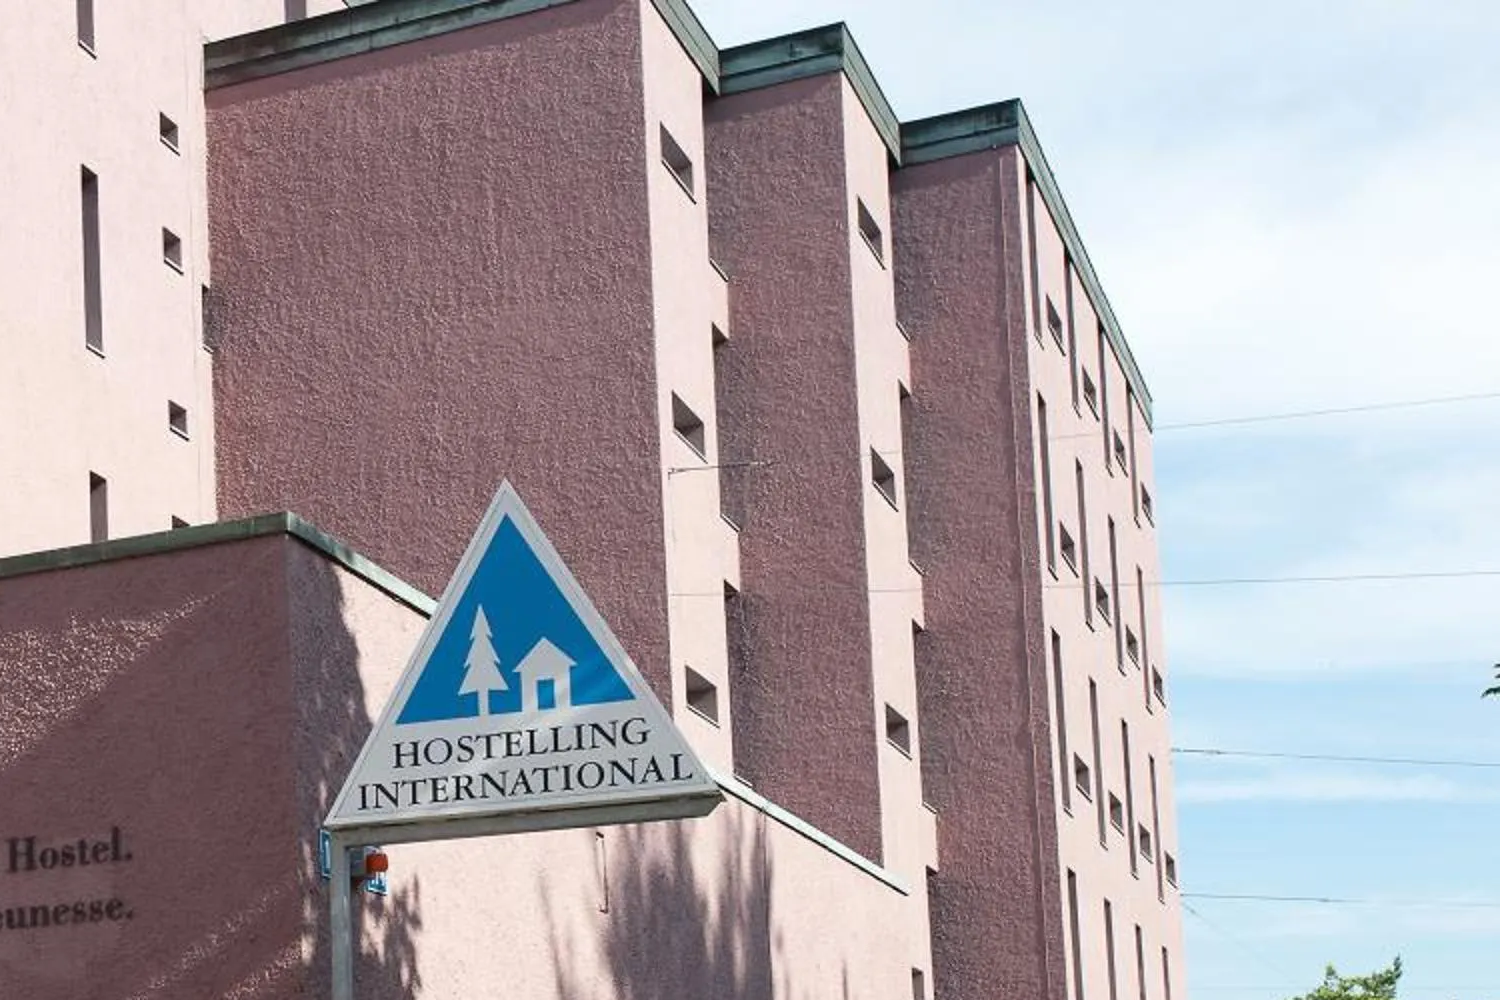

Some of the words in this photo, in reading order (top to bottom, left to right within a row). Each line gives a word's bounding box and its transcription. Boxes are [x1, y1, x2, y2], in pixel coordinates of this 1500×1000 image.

[392, 716, 651, 769] HOSTELLING
[358, 754, 694, 811] INTERNATIONAL
[5, 826, 133, 874] Hostel.
